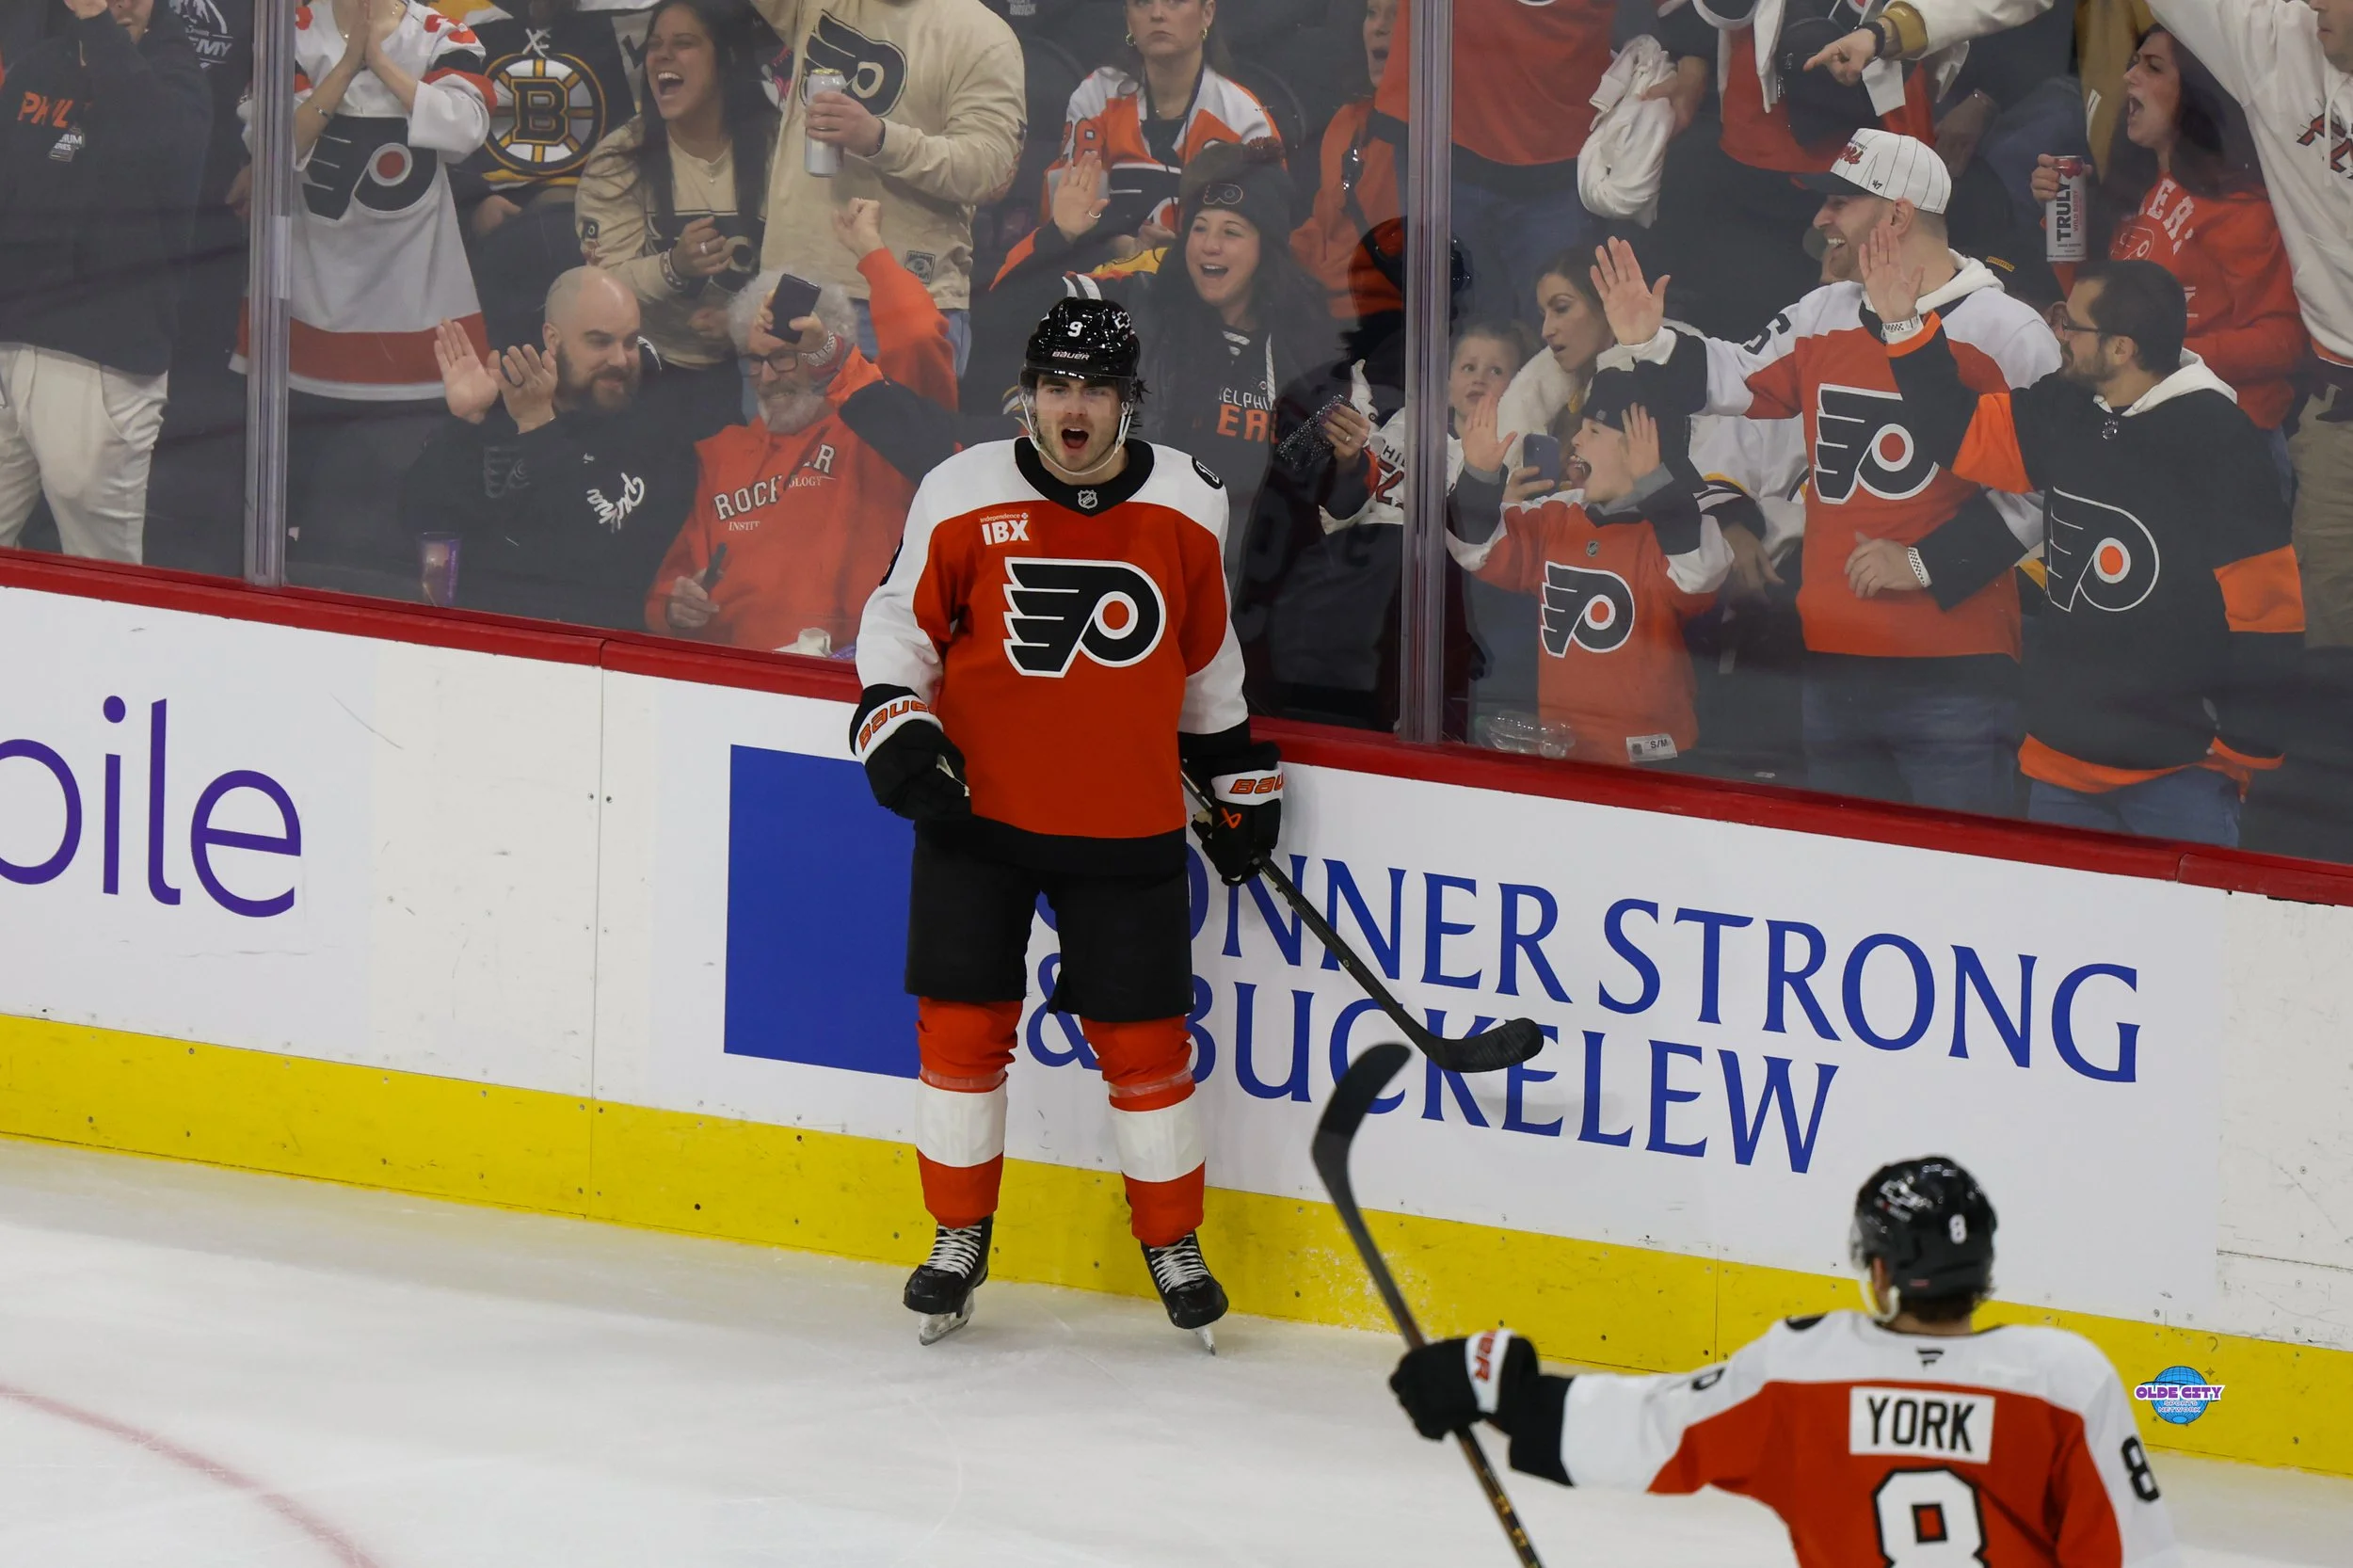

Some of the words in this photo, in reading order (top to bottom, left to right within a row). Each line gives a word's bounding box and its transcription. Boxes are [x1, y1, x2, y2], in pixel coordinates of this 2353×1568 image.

[1067, 321, 1083, 337] 9
[1051, 350, 1090, 360] BAUER
[982, 520, 1030, 546] IBX
[858, 699, 929, 752] BAUE
[1598, 898, 2141, 1083] STRONG
[1948, 1214, 1968, 1244] 8
[1867, 1396, 1977, 1453] YORK
